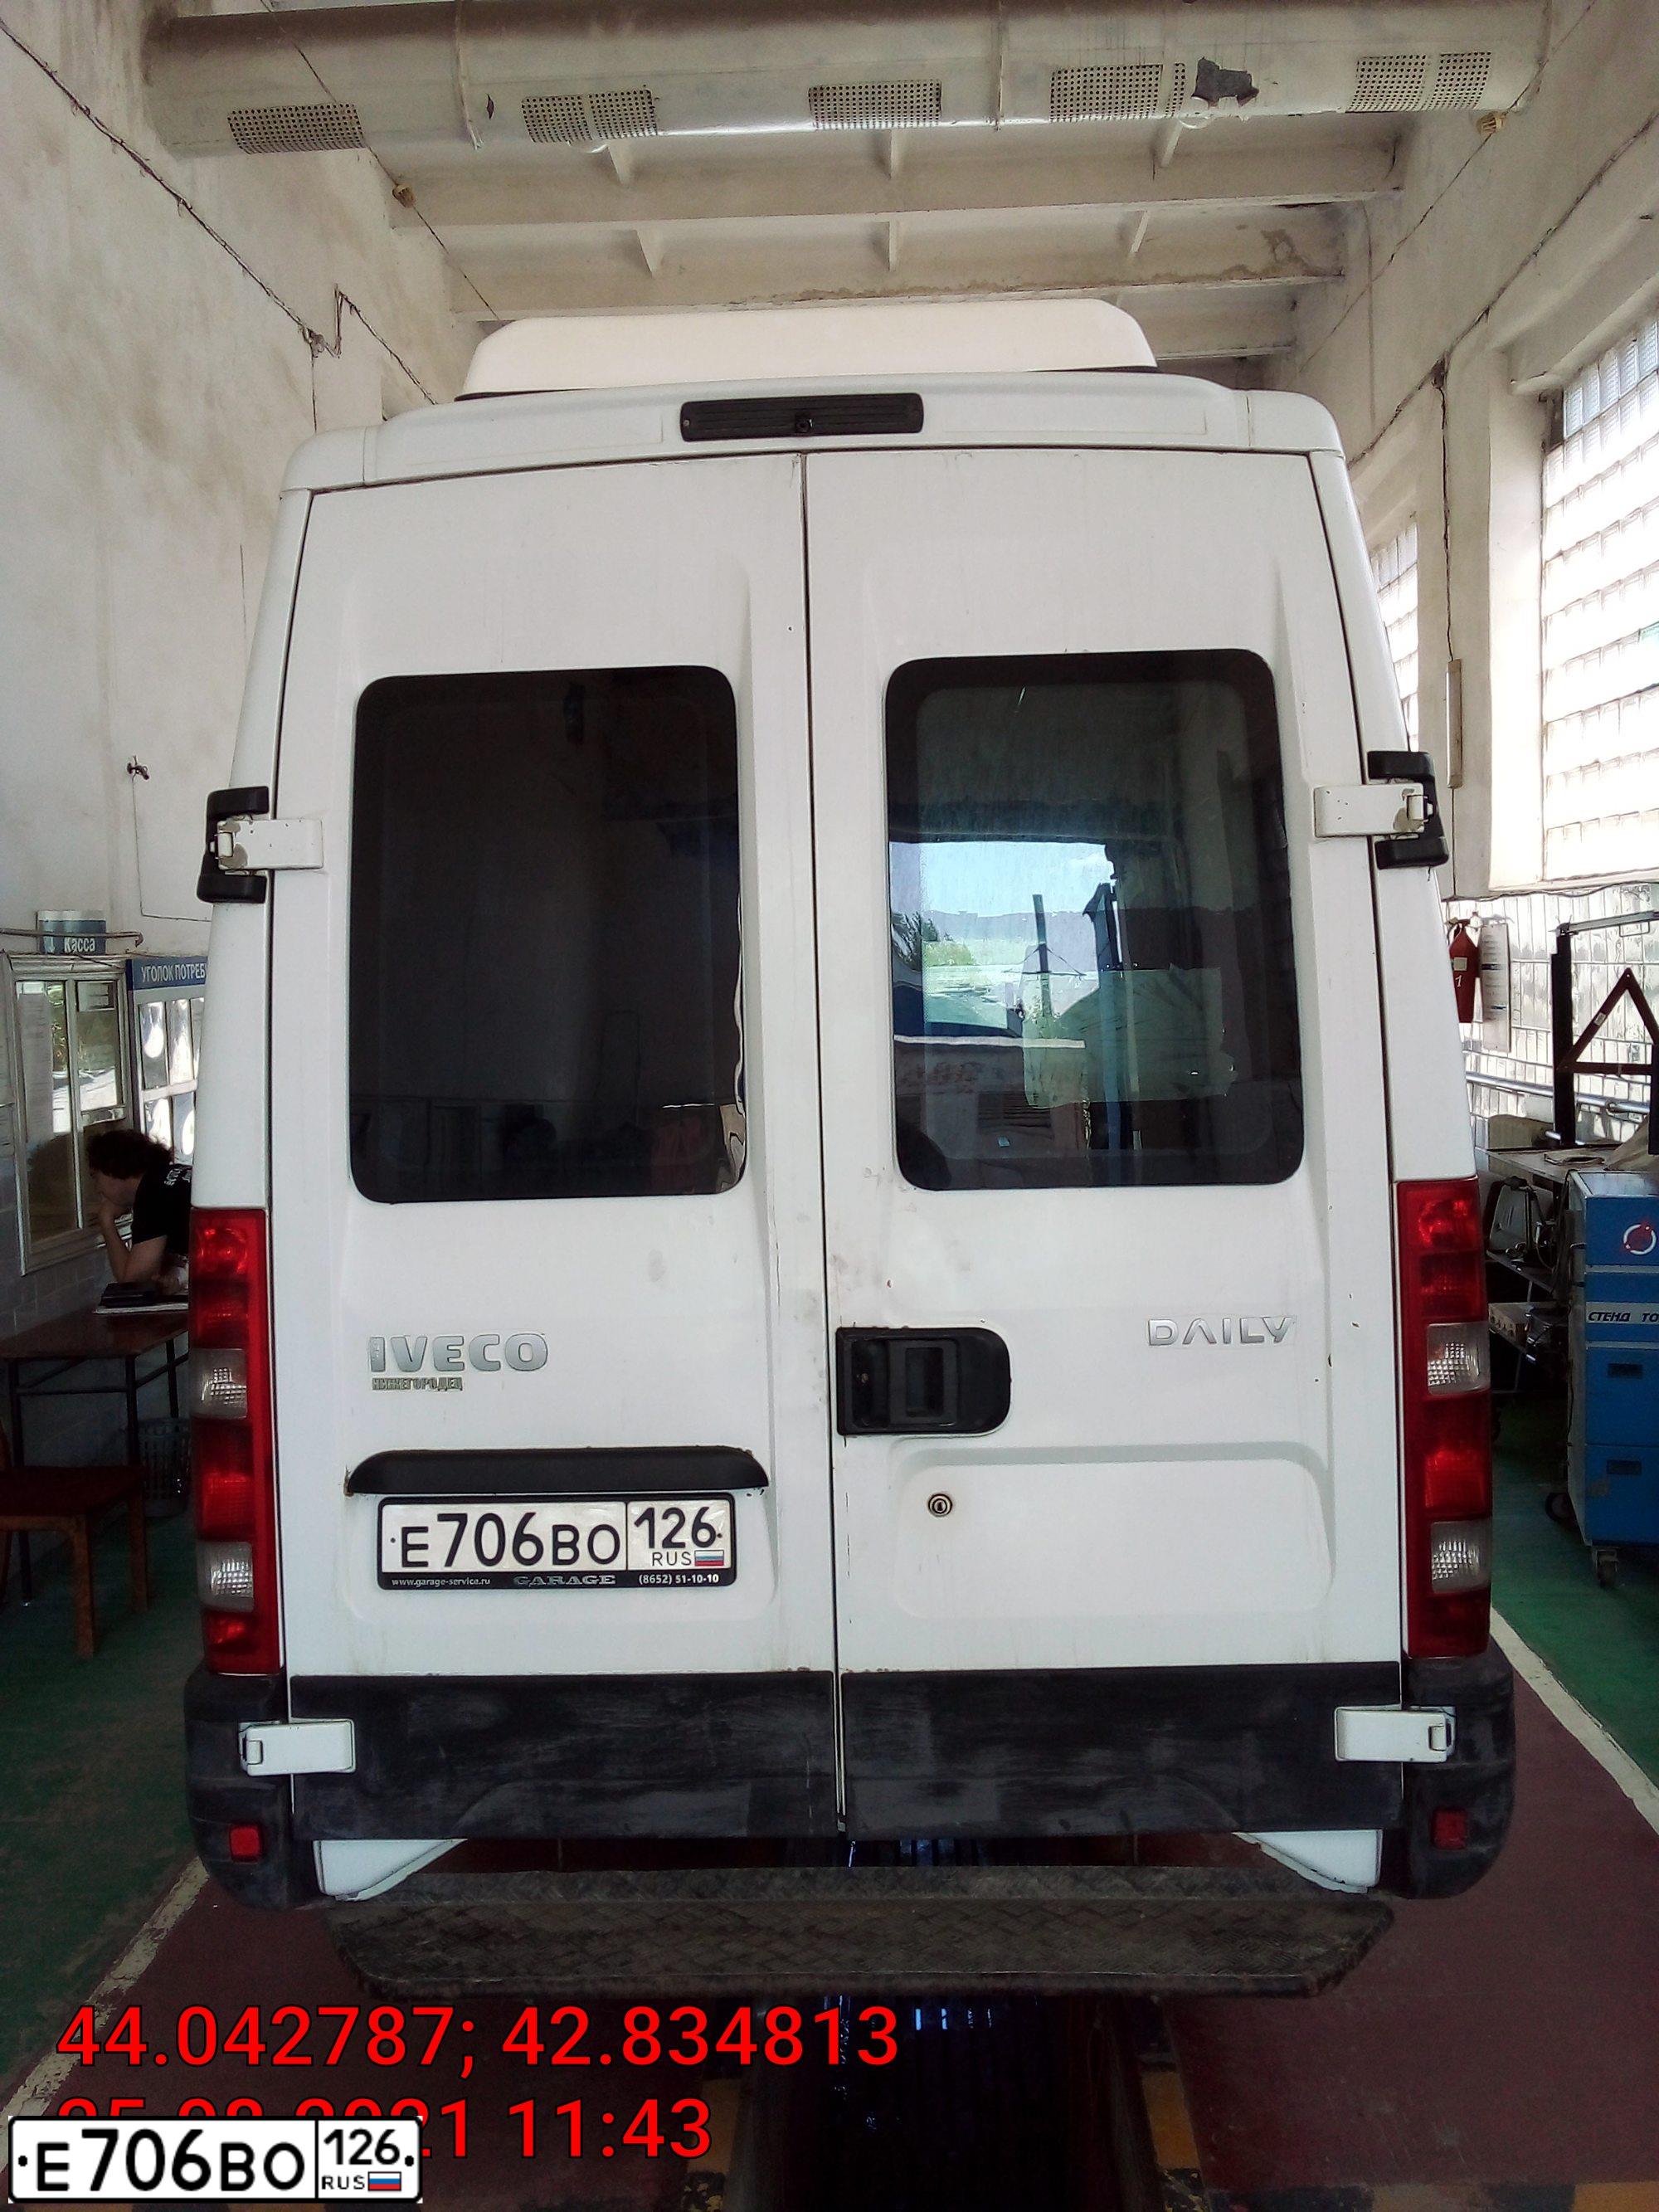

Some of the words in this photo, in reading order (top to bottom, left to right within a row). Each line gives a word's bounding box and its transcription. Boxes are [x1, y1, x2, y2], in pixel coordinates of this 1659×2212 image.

[64, 938, 95, 953] Касса
[141, 963, 173, 983] УГОЛОК
[1588, 1311, 1631, 1323] СТЕНД
[1642, 1313, 1659, 1323] ТО
[1148, 1317, 1295, 1346] DAILY
[369, 1333, 548, 1372] IVECO
[634, 1506, 717, 1549] 126
[651, 1551, 693, 1566] RUS
[392, 1577, 490, 1587] www.garage-service.ru
[513, 1575, 616, 1587] GARAGE
[639, 1575, 673, 1586] (8652)
[675, 1574, 719, 1584] 51-10-10
